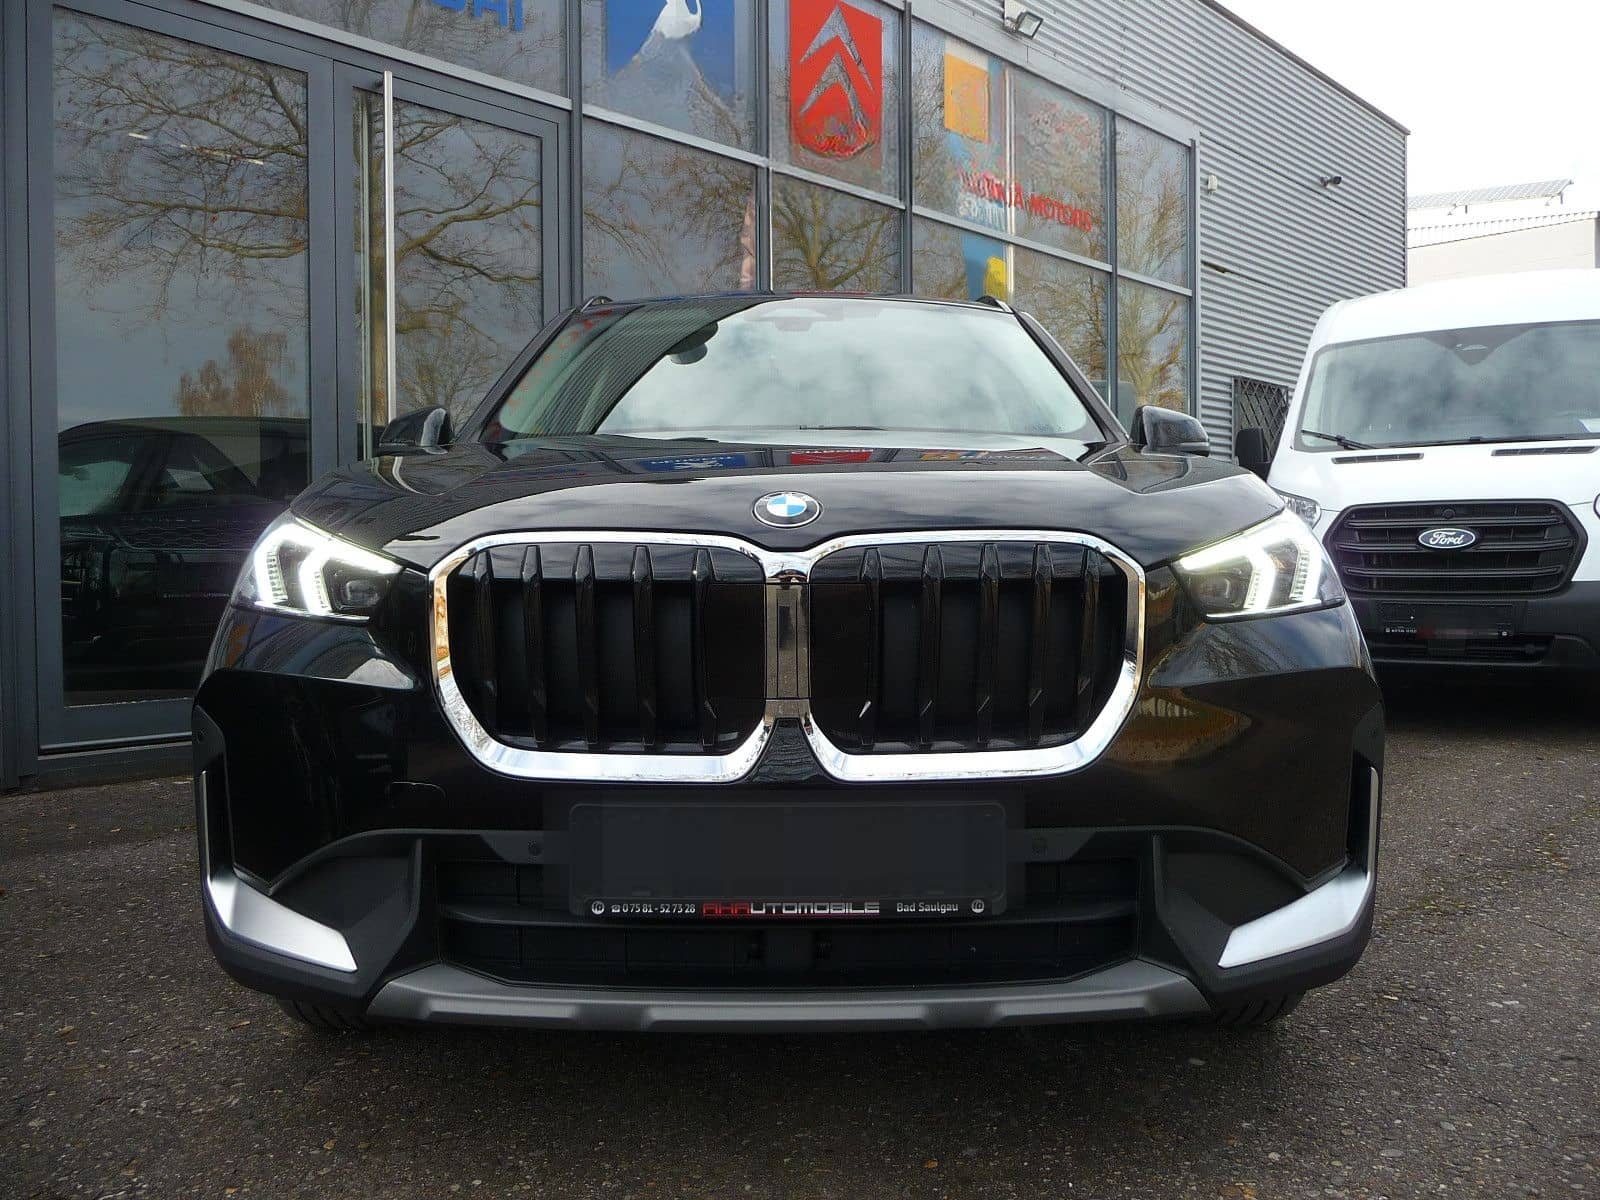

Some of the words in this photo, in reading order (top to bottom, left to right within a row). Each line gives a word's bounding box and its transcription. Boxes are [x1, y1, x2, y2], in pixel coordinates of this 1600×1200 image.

[1429, 531, 1464, 545] Ford
[896, 902, 916, 912] Bad
[918, 901, 959, 914] Saulgau
